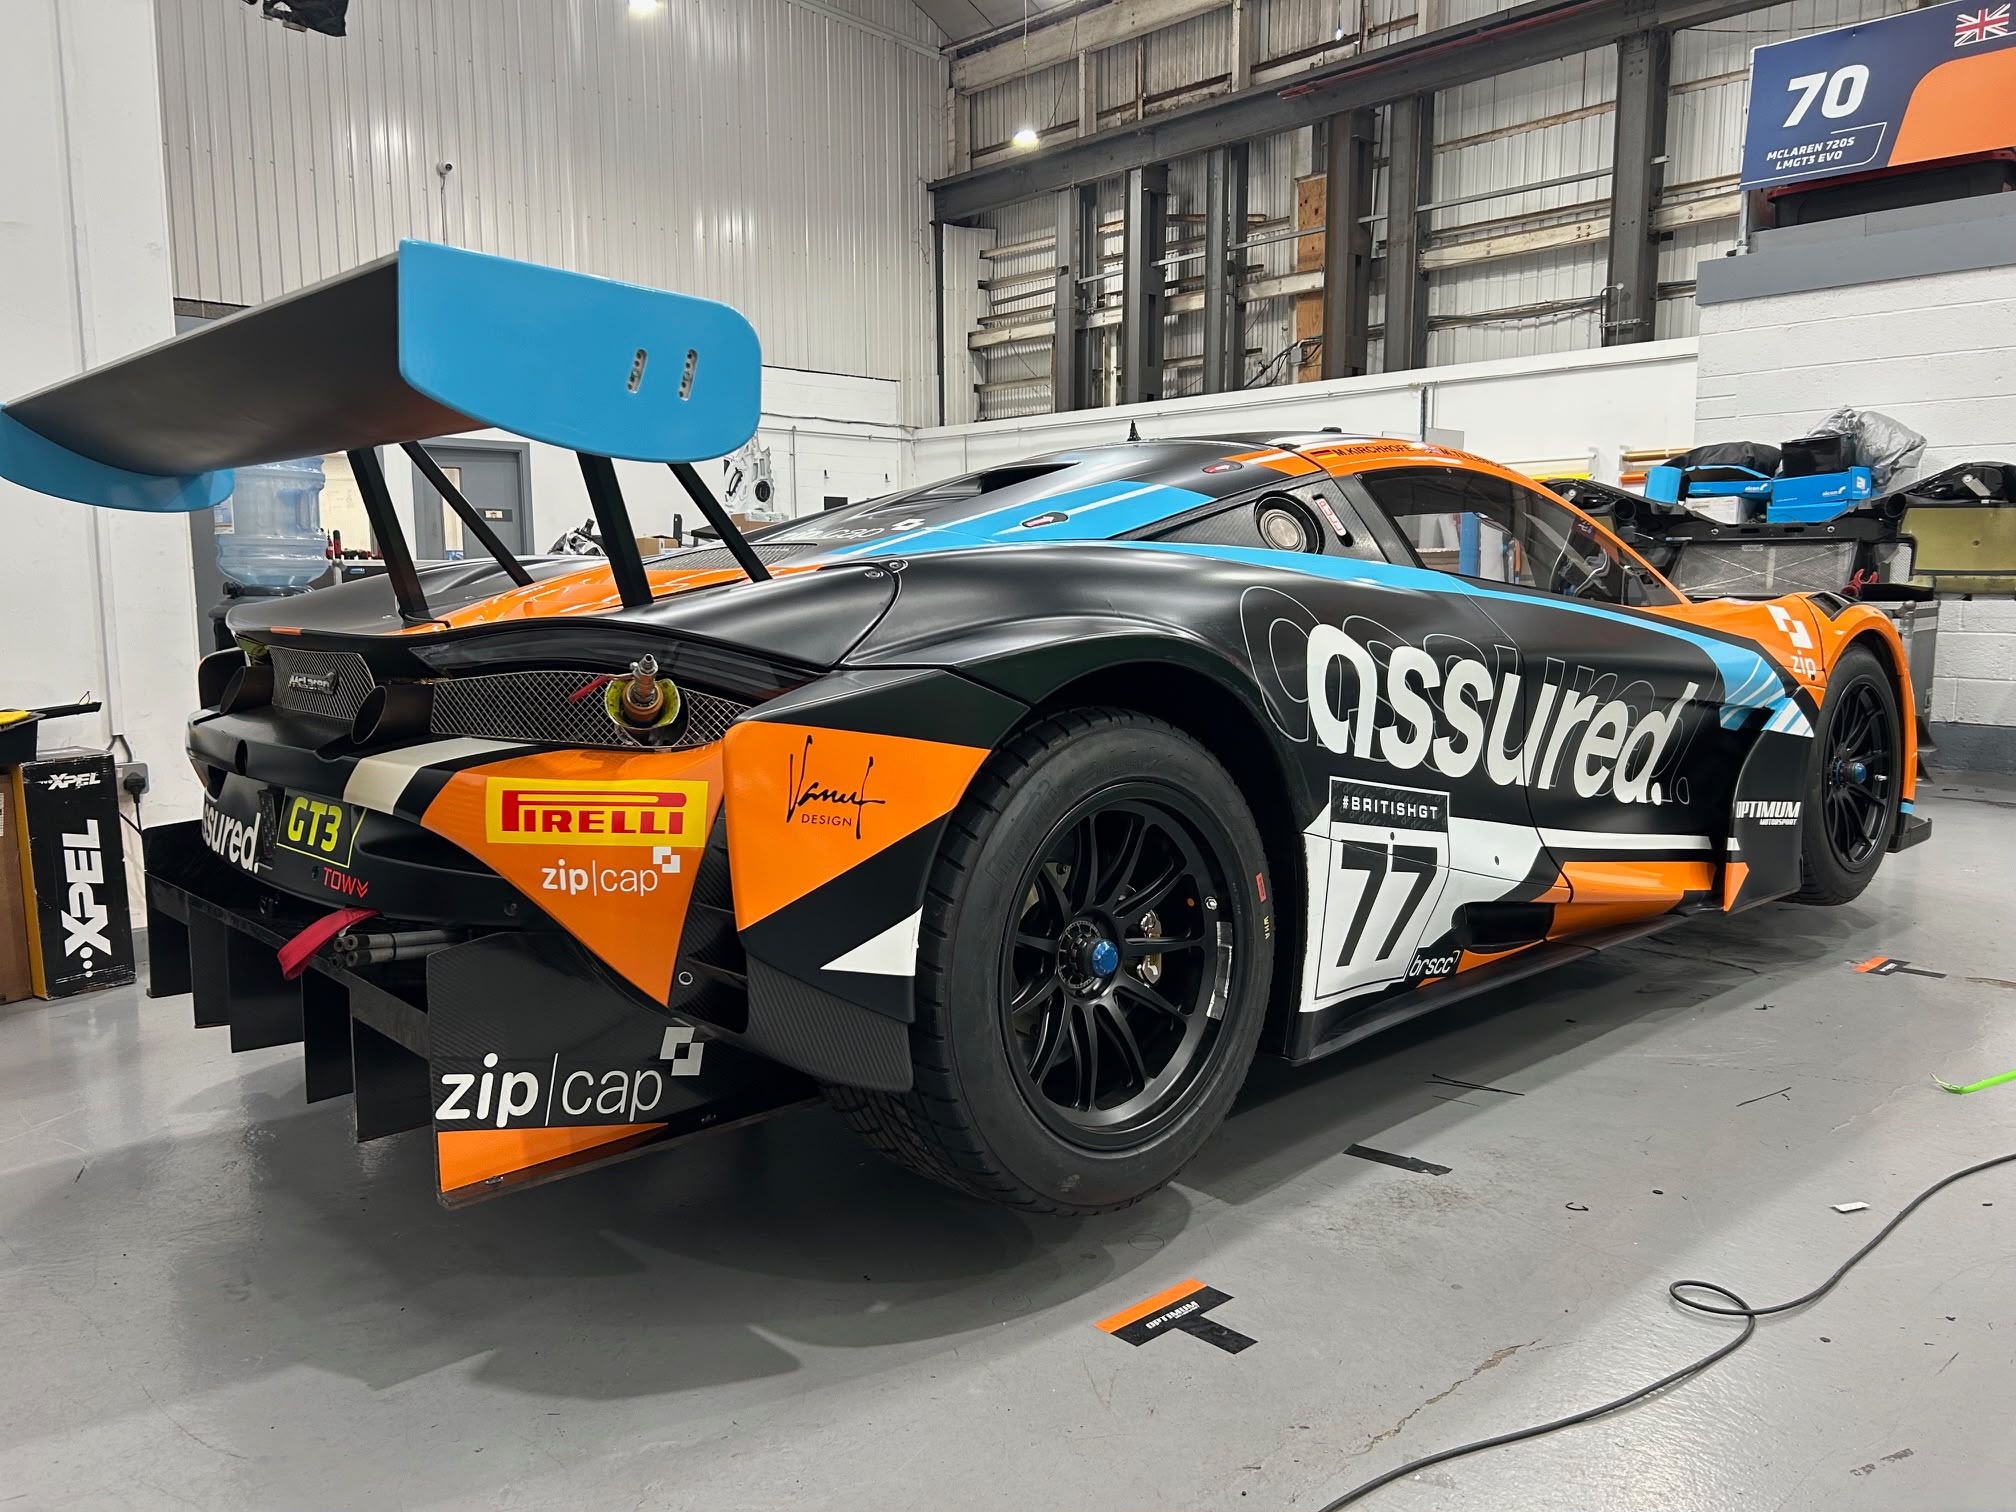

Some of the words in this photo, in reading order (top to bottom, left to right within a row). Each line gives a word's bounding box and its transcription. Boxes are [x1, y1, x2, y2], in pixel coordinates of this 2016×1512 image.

[1783, 64, 1870, 128] 70
[1766, 142, 1824, 161] MCLAREN
[1826, 137, 1856, 151] 720S
[1775, 156, 1816, 171] LMGT3
[1818, 150, 1843, 163] EVO
[1790, 649, 1817, 679] zip
[1306, 623, 1699, 806] assured.
[48, 772, 101, 791] XPEL
[501, 789, 687, 835] PIRELLI
[801, 813, 852, 827] DESIGN
[1341, 794, 1439, 820] #BRITISHGT
[1735, 801, 1802, 819] OPTIMUM
[287, 796, 343, 852] GT3
[61, 818, 112, 958] XPEL
[323, 866, 358, 896] TOW
[1335, 839, 1438, 968] 77
[1409, 954, 1454, 977] brscc
[1145, 1300, 1200, 1329] OPTIMUM
